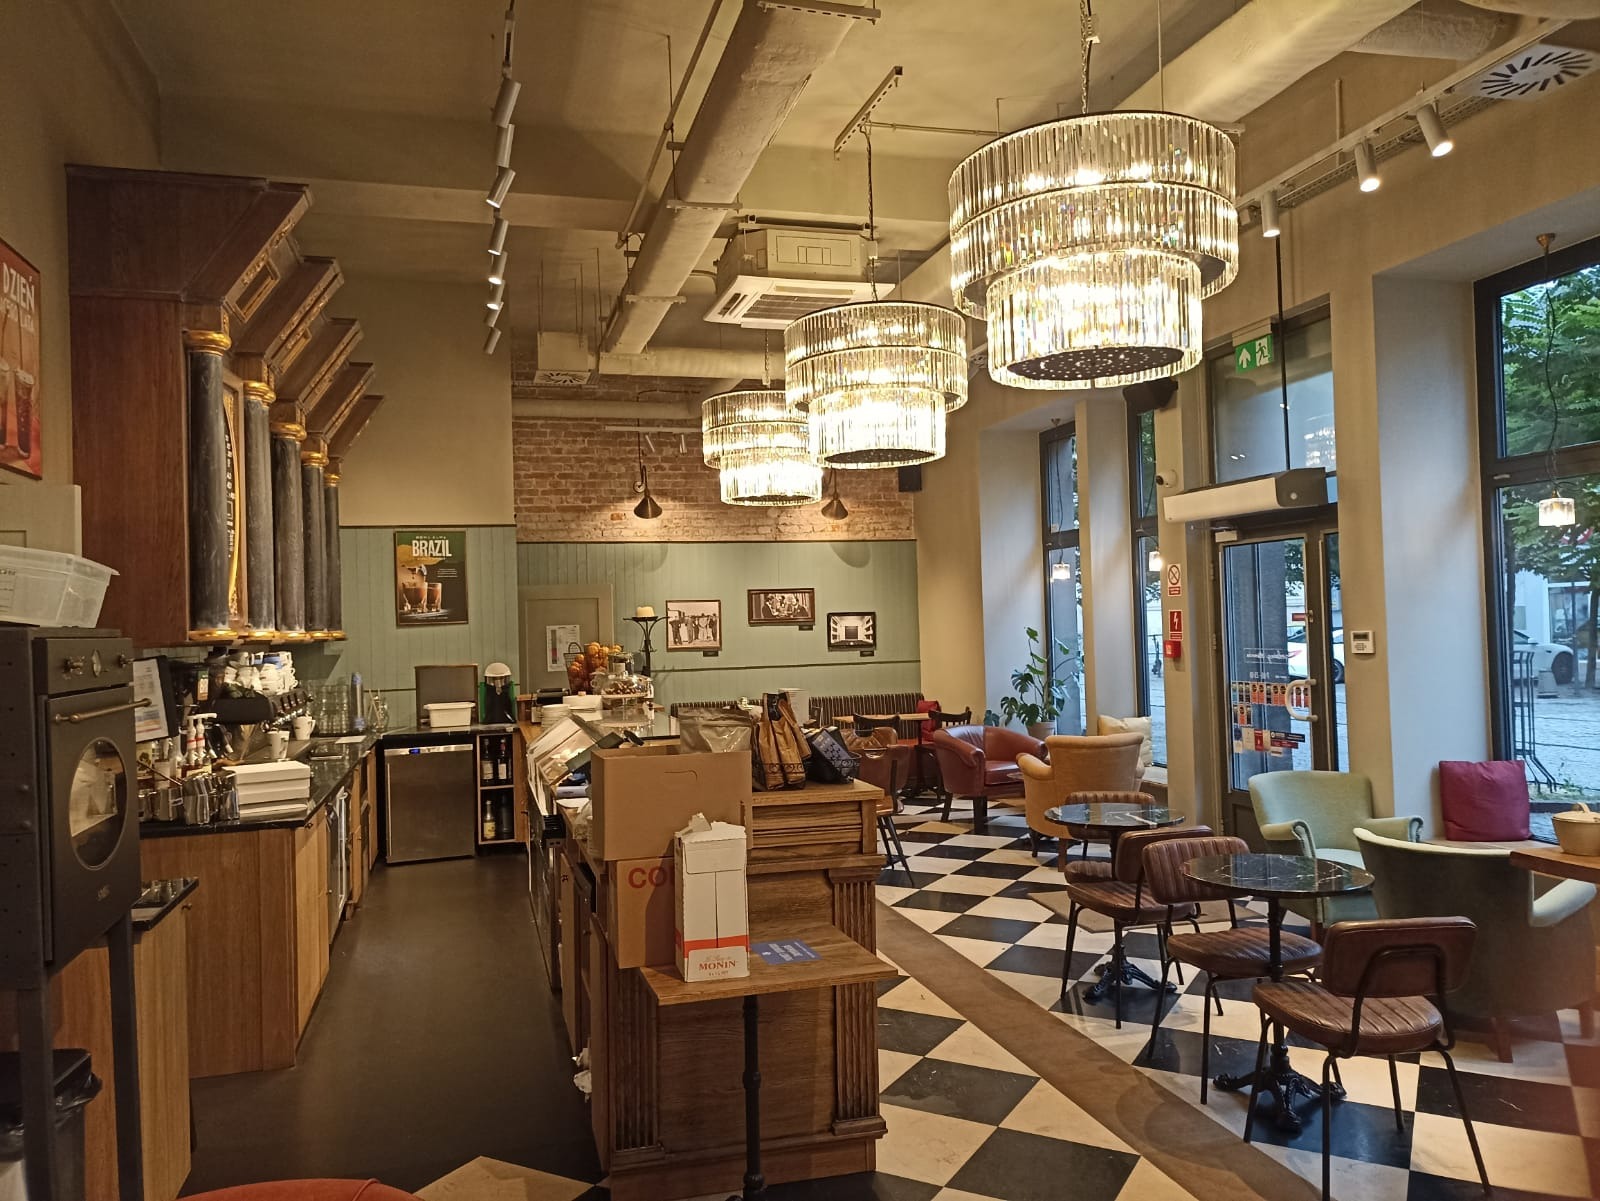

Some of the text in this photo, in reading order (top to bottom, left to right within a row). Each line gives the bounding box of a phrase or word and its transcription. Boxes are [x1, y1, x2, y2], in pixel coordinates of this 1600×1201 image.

[3, 262, 35, 313] DZIEŃ
[412, 540, 452, 556] BRAZIL
[699, 960, 736, 971] MONIN
